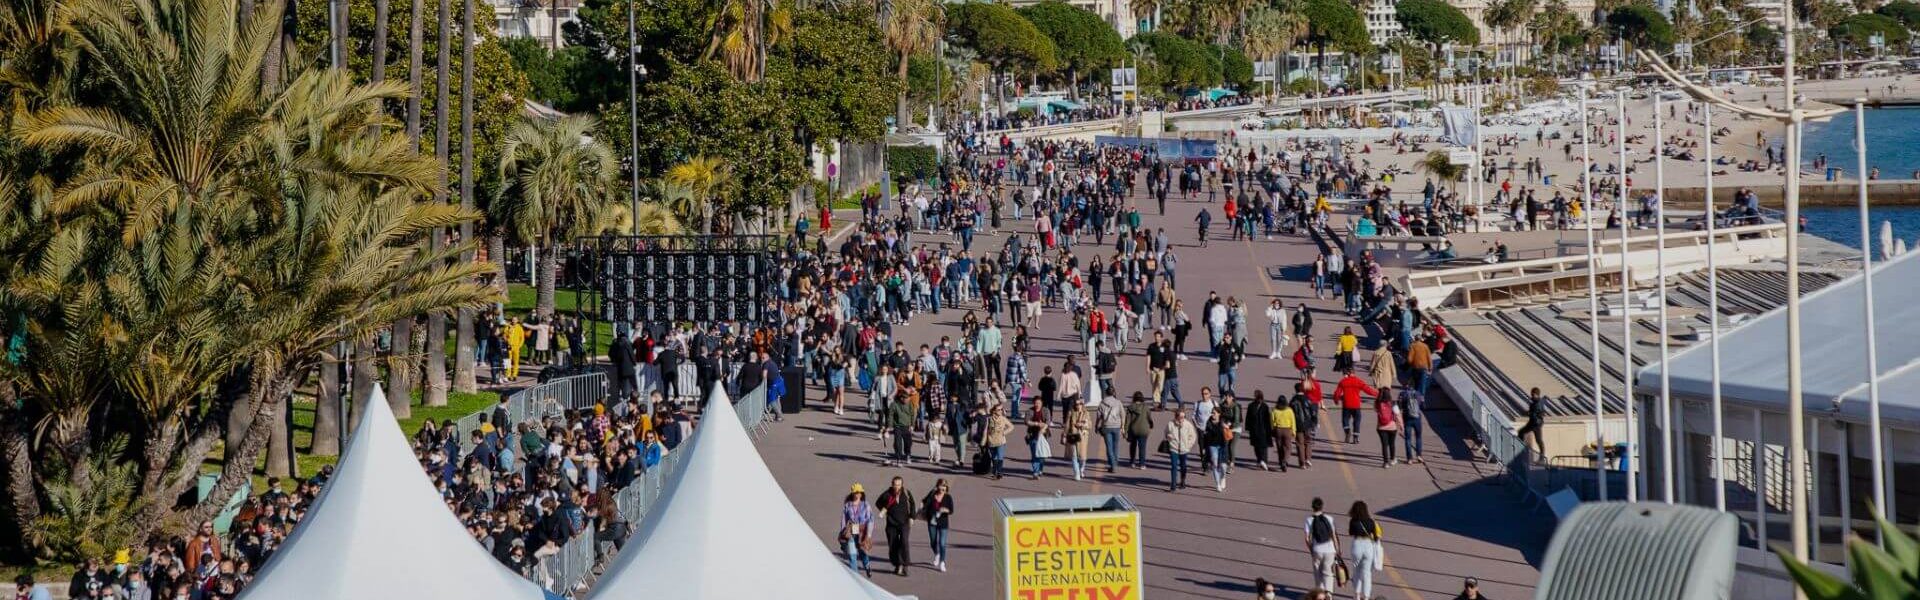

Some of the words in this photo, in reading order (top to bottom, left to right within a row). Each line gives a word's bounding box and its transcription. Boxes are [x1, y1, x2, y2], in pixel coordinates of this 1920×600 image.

[1016, 524, 1131, 548] CANNES
[1017, 548, 1131, 572] FESTIVAL
[1017, 570, 1132, 586] INTERNATIONAL
